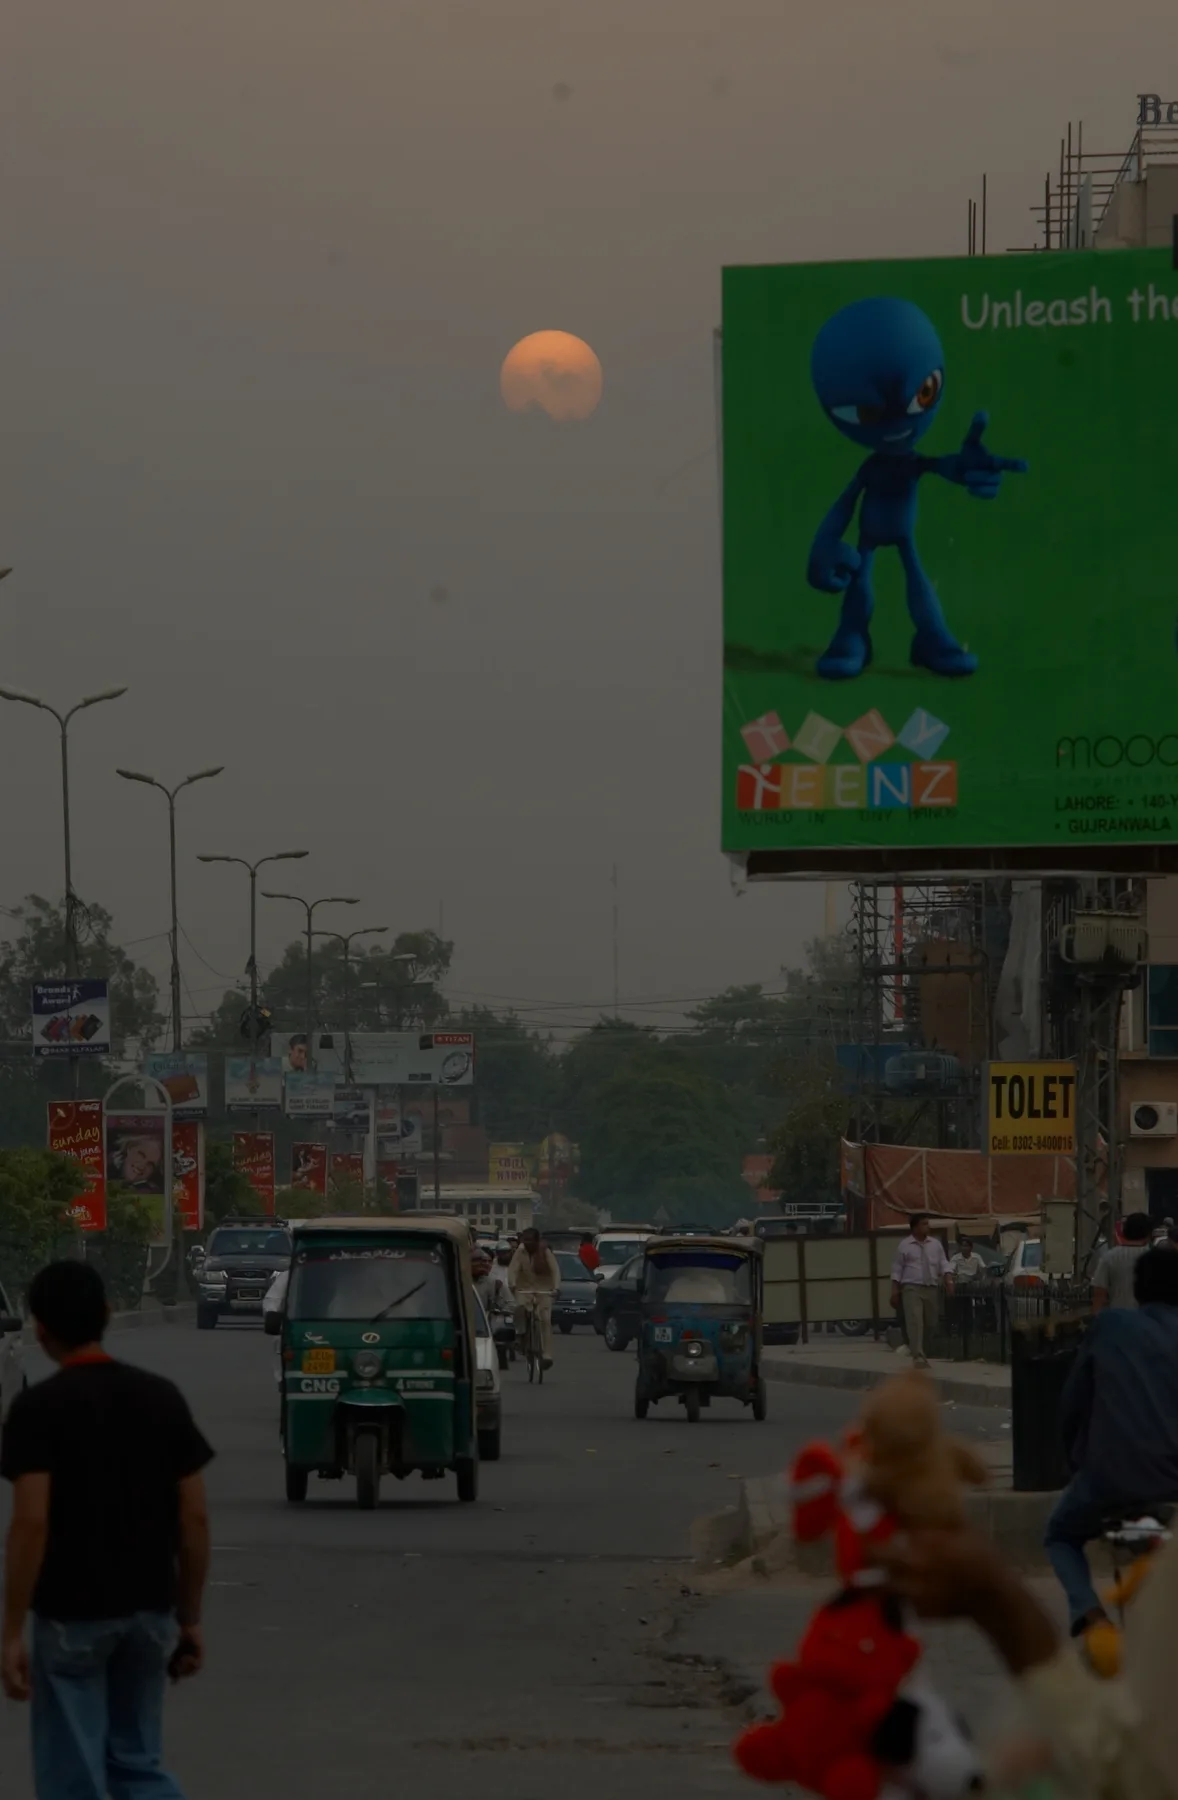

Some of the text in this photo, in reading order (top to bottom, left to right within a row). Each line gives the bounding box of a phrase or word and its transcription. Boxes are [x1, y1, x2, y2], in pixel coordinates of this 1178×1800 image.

[961, 285, 1112, 329] Unleash
[740, 711, 945, 759] TINY
[737, 764, 953, 809] TEENZ
[1068, 817, 1173, 833] GUJRANWALA
[991, 1075, 1075, 1119] TOLET
[52, 1126, 101, 1150] sunday
[992, 1135, 1011, 1151] Cell:
[300, 1379, 341, 1393] CNG
[395, 1378, 405, 1391] 4
